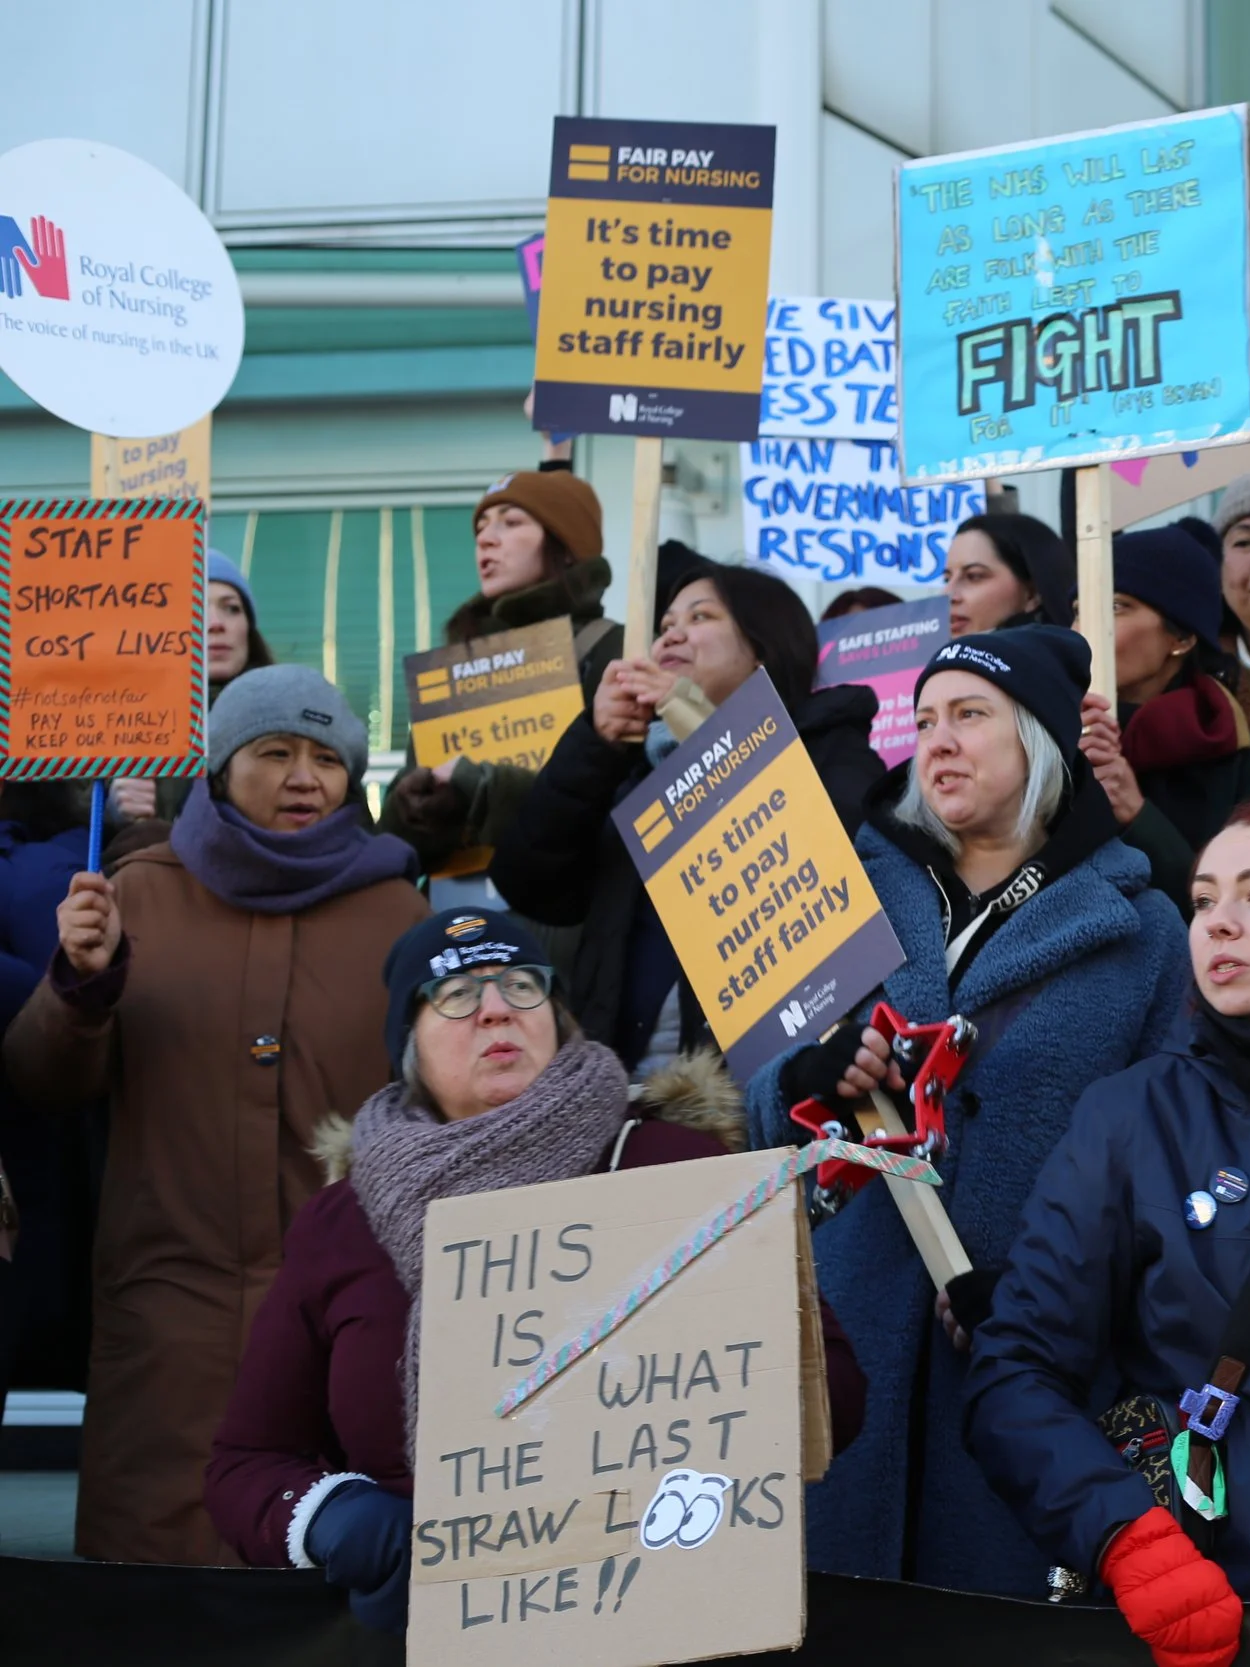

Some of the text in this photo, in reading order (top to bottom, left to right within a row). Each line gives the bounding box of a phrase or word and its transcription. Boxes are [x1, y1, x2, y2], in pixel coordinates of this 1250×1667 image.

[616, 166, 760, 189] FOR NURSING
[617, 147, 714, 168] FAIR PAY
[990, 165, 1048, 200] NHS
[1062, 154, 1126, 187] WILL
[1141, 139, 1196, 175] LAST
[648, 219, 732, 250] time
[937, 178, 1202, 256] AS LONG AS THERE
[80, 255, 213, 301] Royal College
[600, 257, 713, 292] to pay
[926, 265, 970, 295] ARE
[985, 250, 1037, 283] FOLK
[1115, 230, 1161, 261] THE
[82, 286, 188, 327] of Nursing
[584, 294, 722, 330] nursing
[942, 270, 1143, 327] FAITH LEFT TO
[28, 320, 220, 360] voice of nursing in the UK
[557, 330, 745, 370] staff fairly
[956, 290, 1183, 416] FIGHT
[969, 414, 1014, 444] FOR
[744, 476, 985, 528] GOVERNMENTS
[24, 524, 144, 560] STAFF
[15, 582, 173, 612] SHORTAGES
[25, 629, 192, 661] COST LIVES
[838, 618, 940, 653] SAFE STAFFING
[452, 649, 526, 680] FAIR PAY
[455, 655, 565, 697] FOR NURSING
[26, 733, 68, 750] KEEP
[76, 731, 104, 746] OUR
[31, 712, 62, 730] PAY
[490, 712, 556, 743] time
[665, 730, 734, 806] FAIR PAY
[673, 716, 778, 821] FOR NURSING
[722, 788, 787, 854] time
[708, 831, 790, 917] to pay
[716, 858, 820, 962] nursing
[718, 876, 850, 1012] staff fairly
[443, 1223, 594, 1300] THIS
[493, 1309, 545, 1368] IS
[598, 1341, 763, 1410] WHAT
[440, 1410, 748, 1498] THE LAST
[416, 1498, 582, 1566] STRAW
[460, 1556, 642, 1630] LIKE!!
